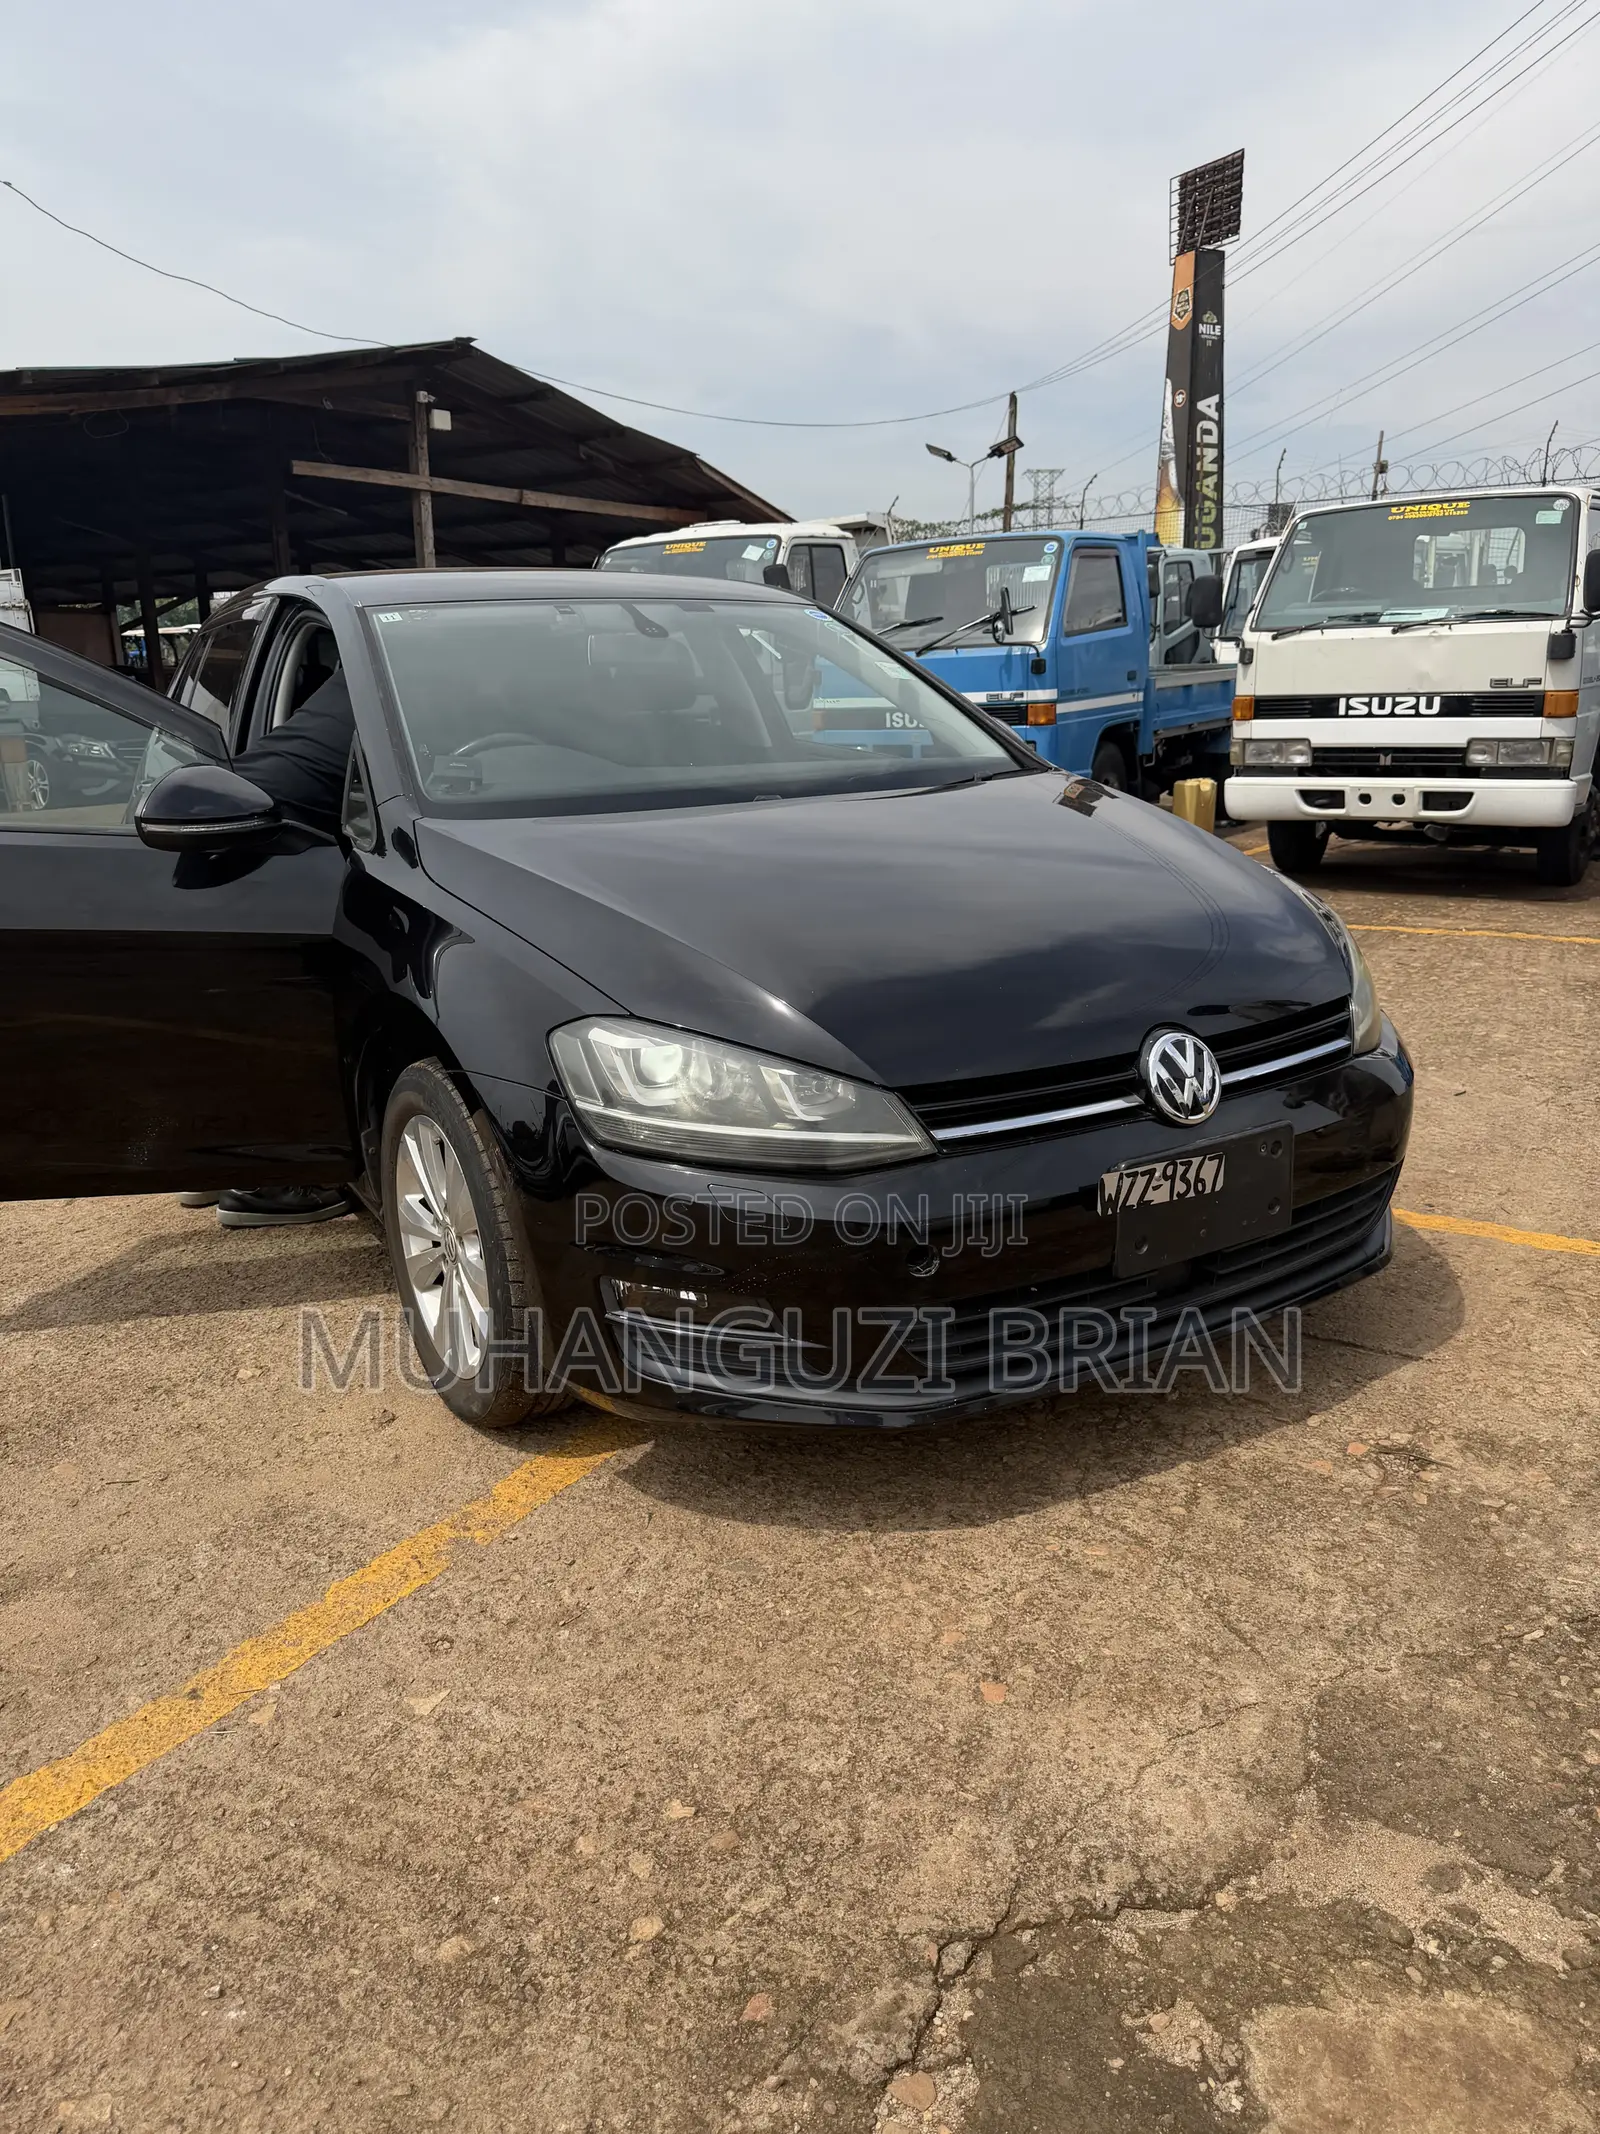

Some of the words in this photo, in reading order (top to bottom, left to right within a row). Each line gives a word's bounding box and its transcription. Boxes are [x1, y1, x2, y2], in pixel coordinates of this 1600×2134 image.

[1198, 323, 1221, 336] NILE
[1194, 394, 1220, 549] UGANDA
[1390, 501, 1471, 513] UNIQUE
[928, 543, 986, 553] UNIQUE
[1489, 677, 1542, 689] ELF
[985, 692, 1024, 702] ELF
[1338, 696, 1441, 716] ISUZU
[885, 711, 925, 728] ISU
